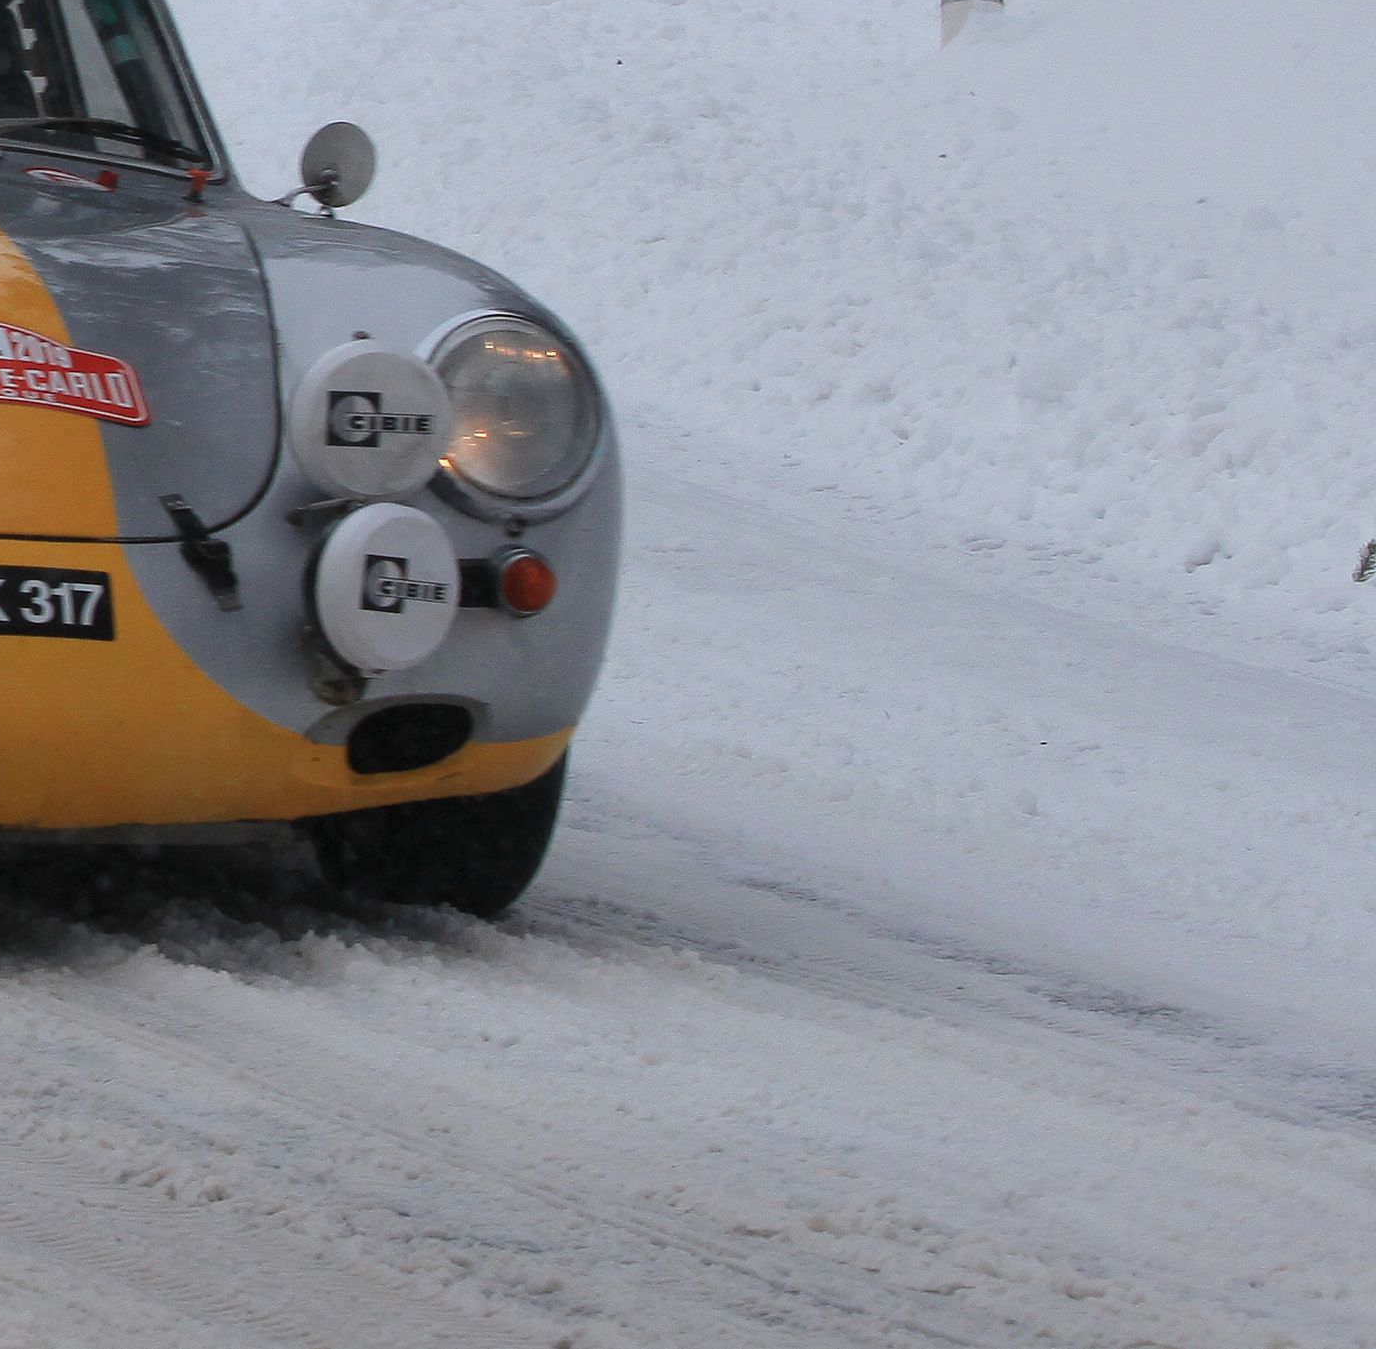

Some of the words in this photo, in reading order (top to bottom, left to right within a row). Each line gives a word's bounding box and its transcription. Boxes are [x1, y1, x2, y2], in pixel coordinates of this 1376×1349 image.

[350, 413, 432, 433] CIBIE
[380, 578, 447, 601] CIBIE
[19, 579, 105, 626] 317
